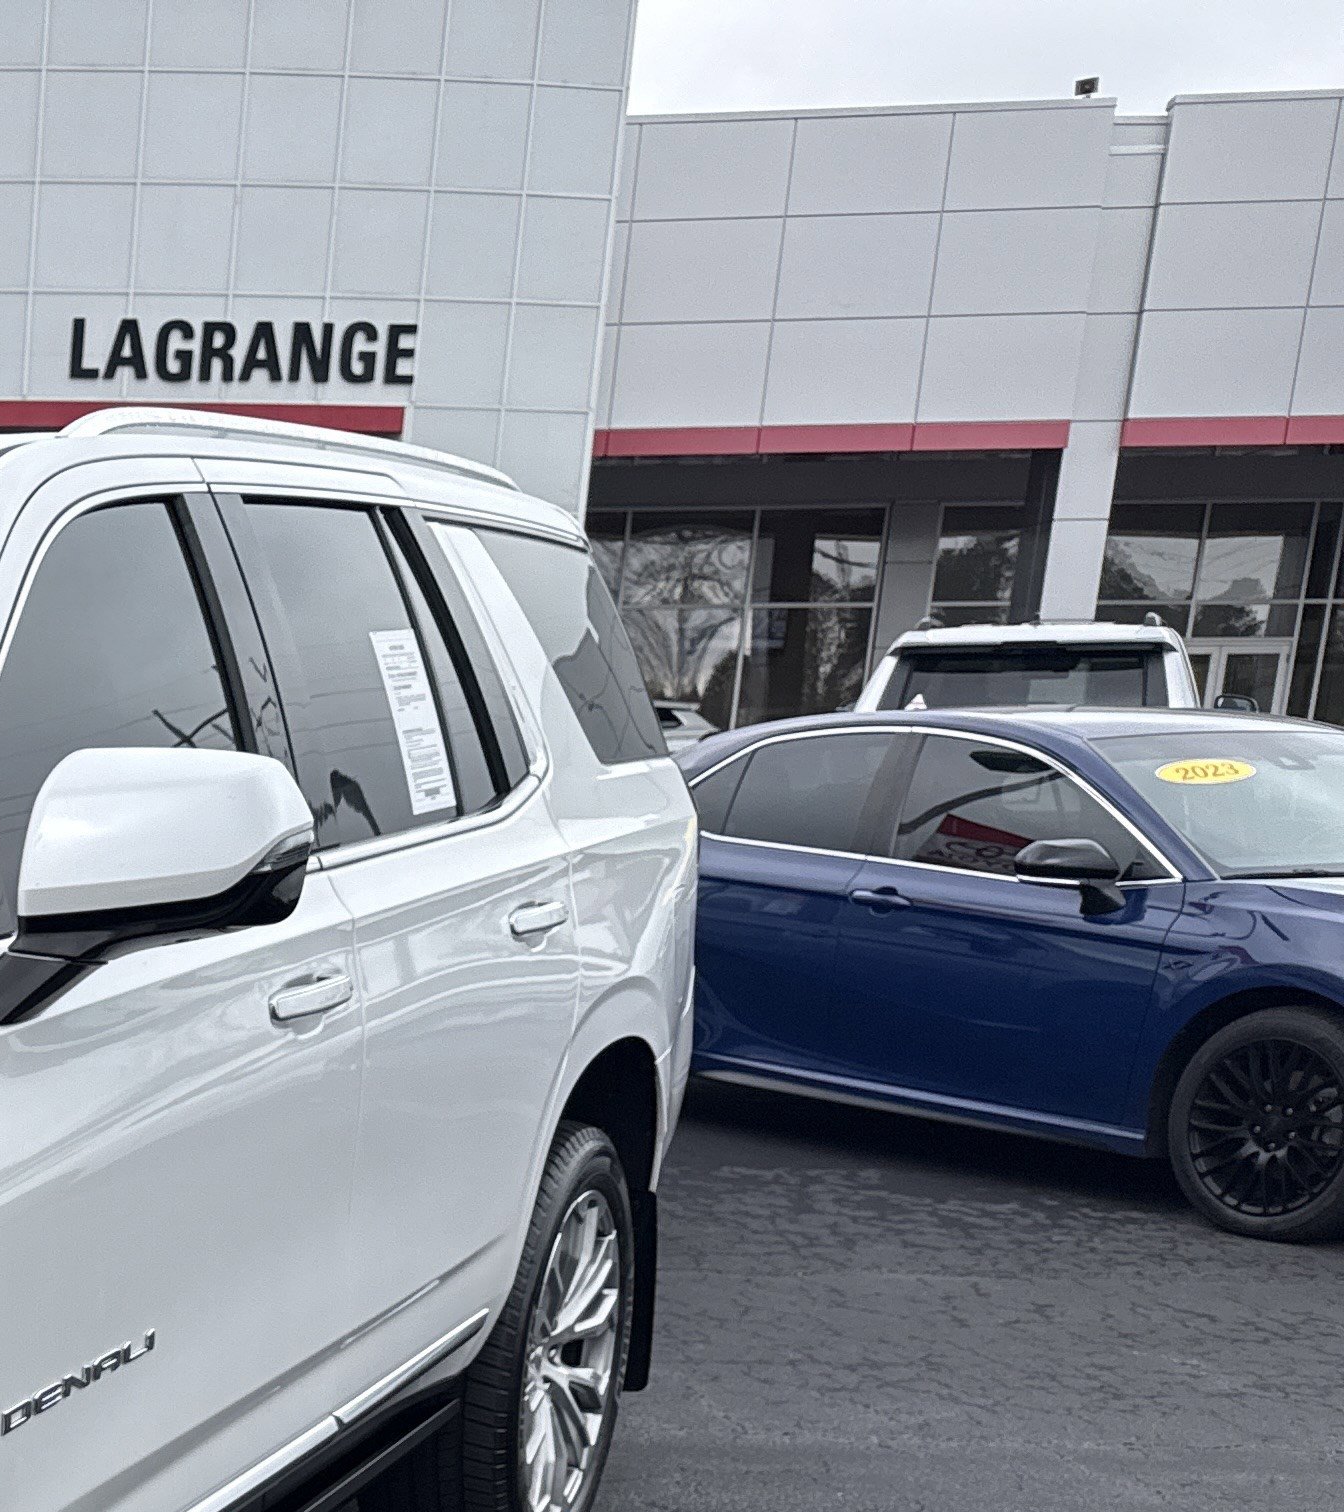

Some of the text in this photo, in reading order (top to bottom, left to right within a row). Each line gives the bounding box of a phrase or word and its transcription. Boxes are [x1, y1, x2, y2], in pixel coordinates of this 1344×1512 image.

[69, 316, 418, 386] LAGRANGE
[1175, 763, 1240, 781] 2023
[0, 1328, 156, 1437] DENALI
